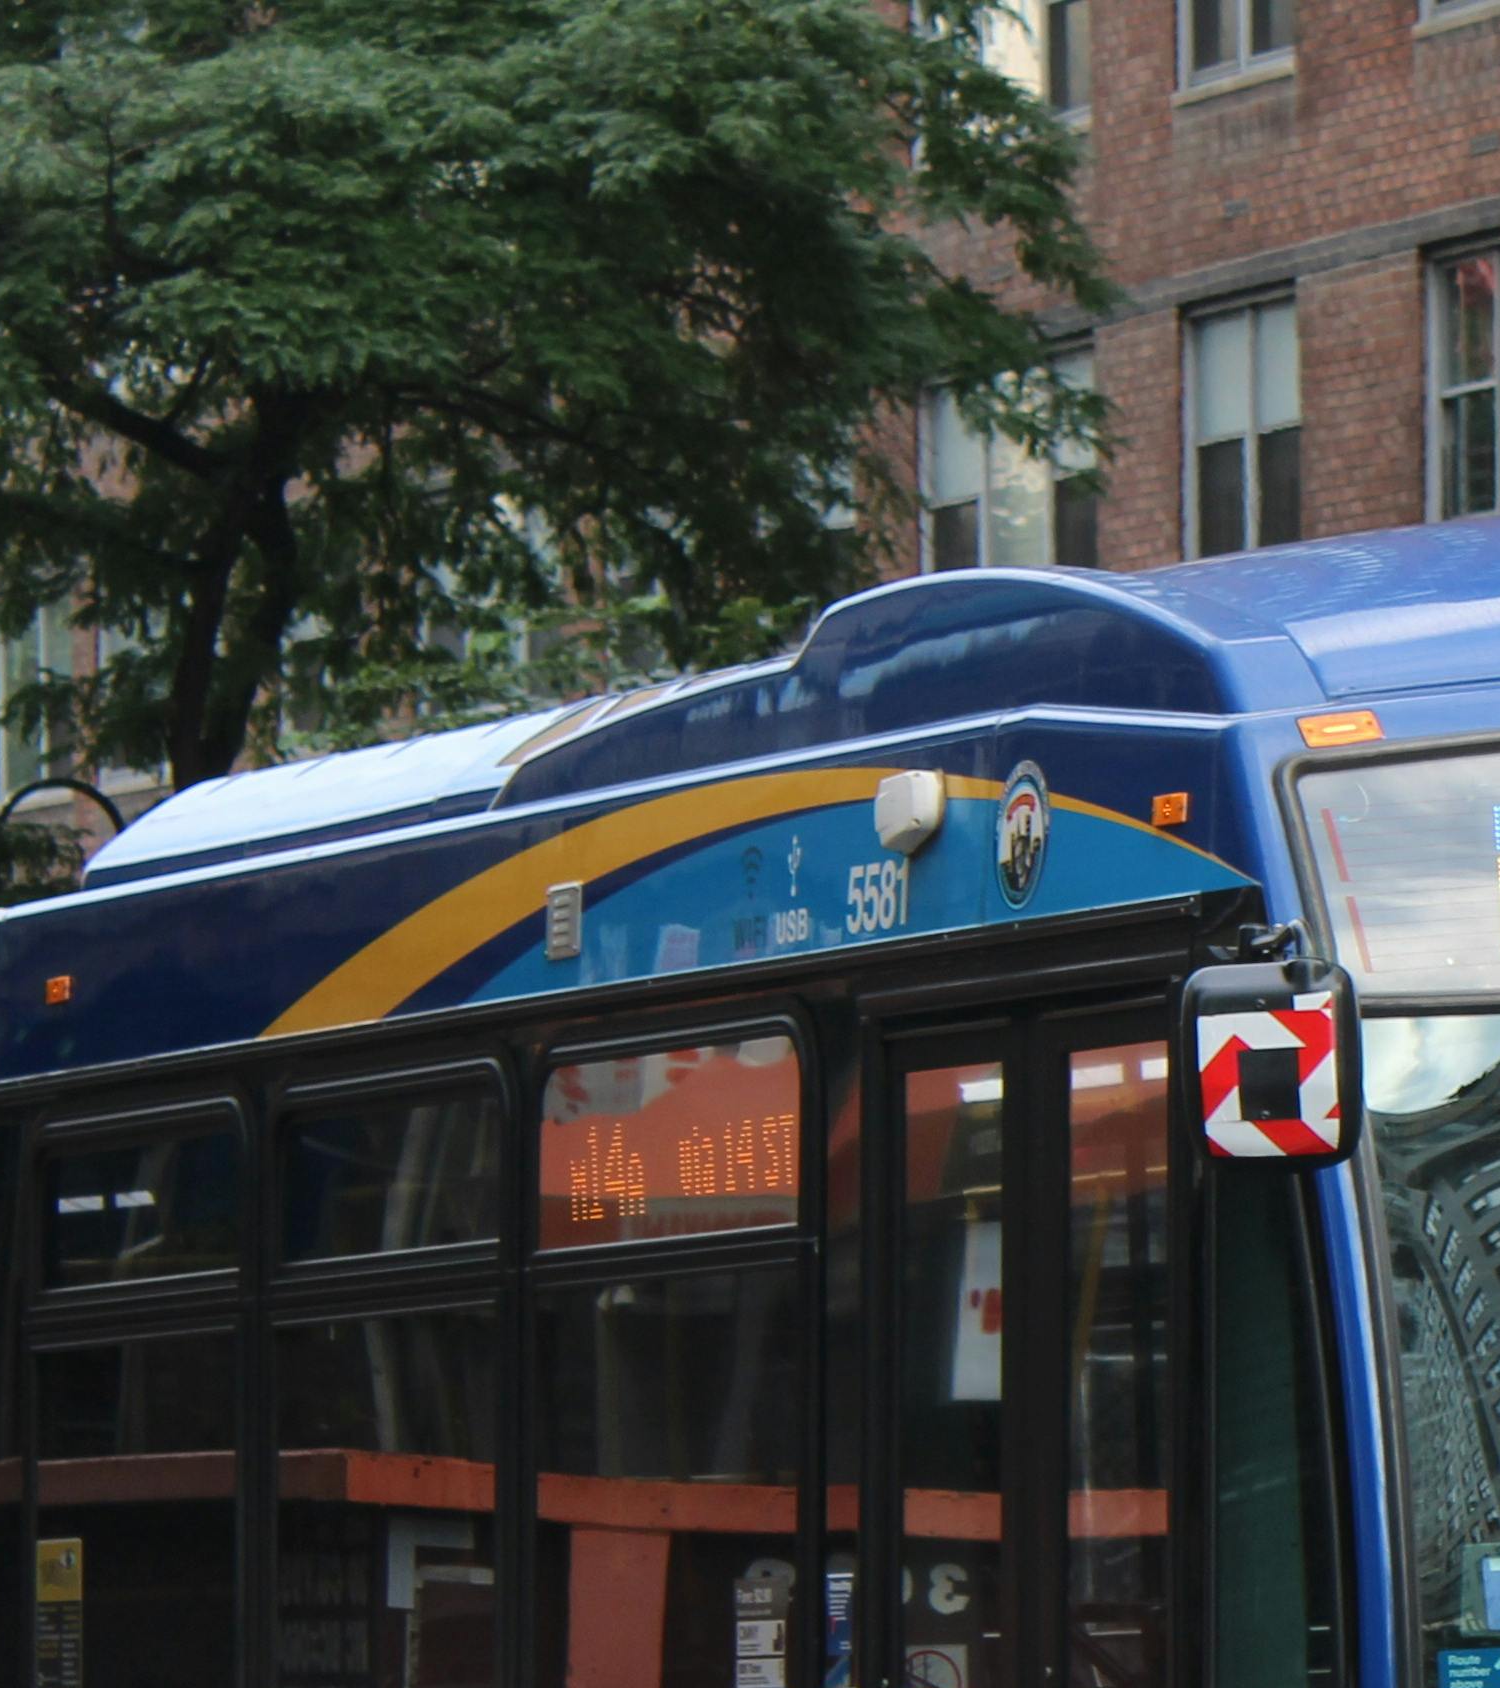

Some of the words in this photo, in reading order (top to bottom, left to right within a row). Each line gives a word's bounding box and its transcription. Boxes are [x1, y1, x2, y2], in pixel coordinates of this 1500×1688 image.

[847, 856, 911, 935] 5581
[776, 907, 809, 945] USB
[1447, 1655, 1481, 1666] Route
[1449, 1666, 1492, 1678] number
